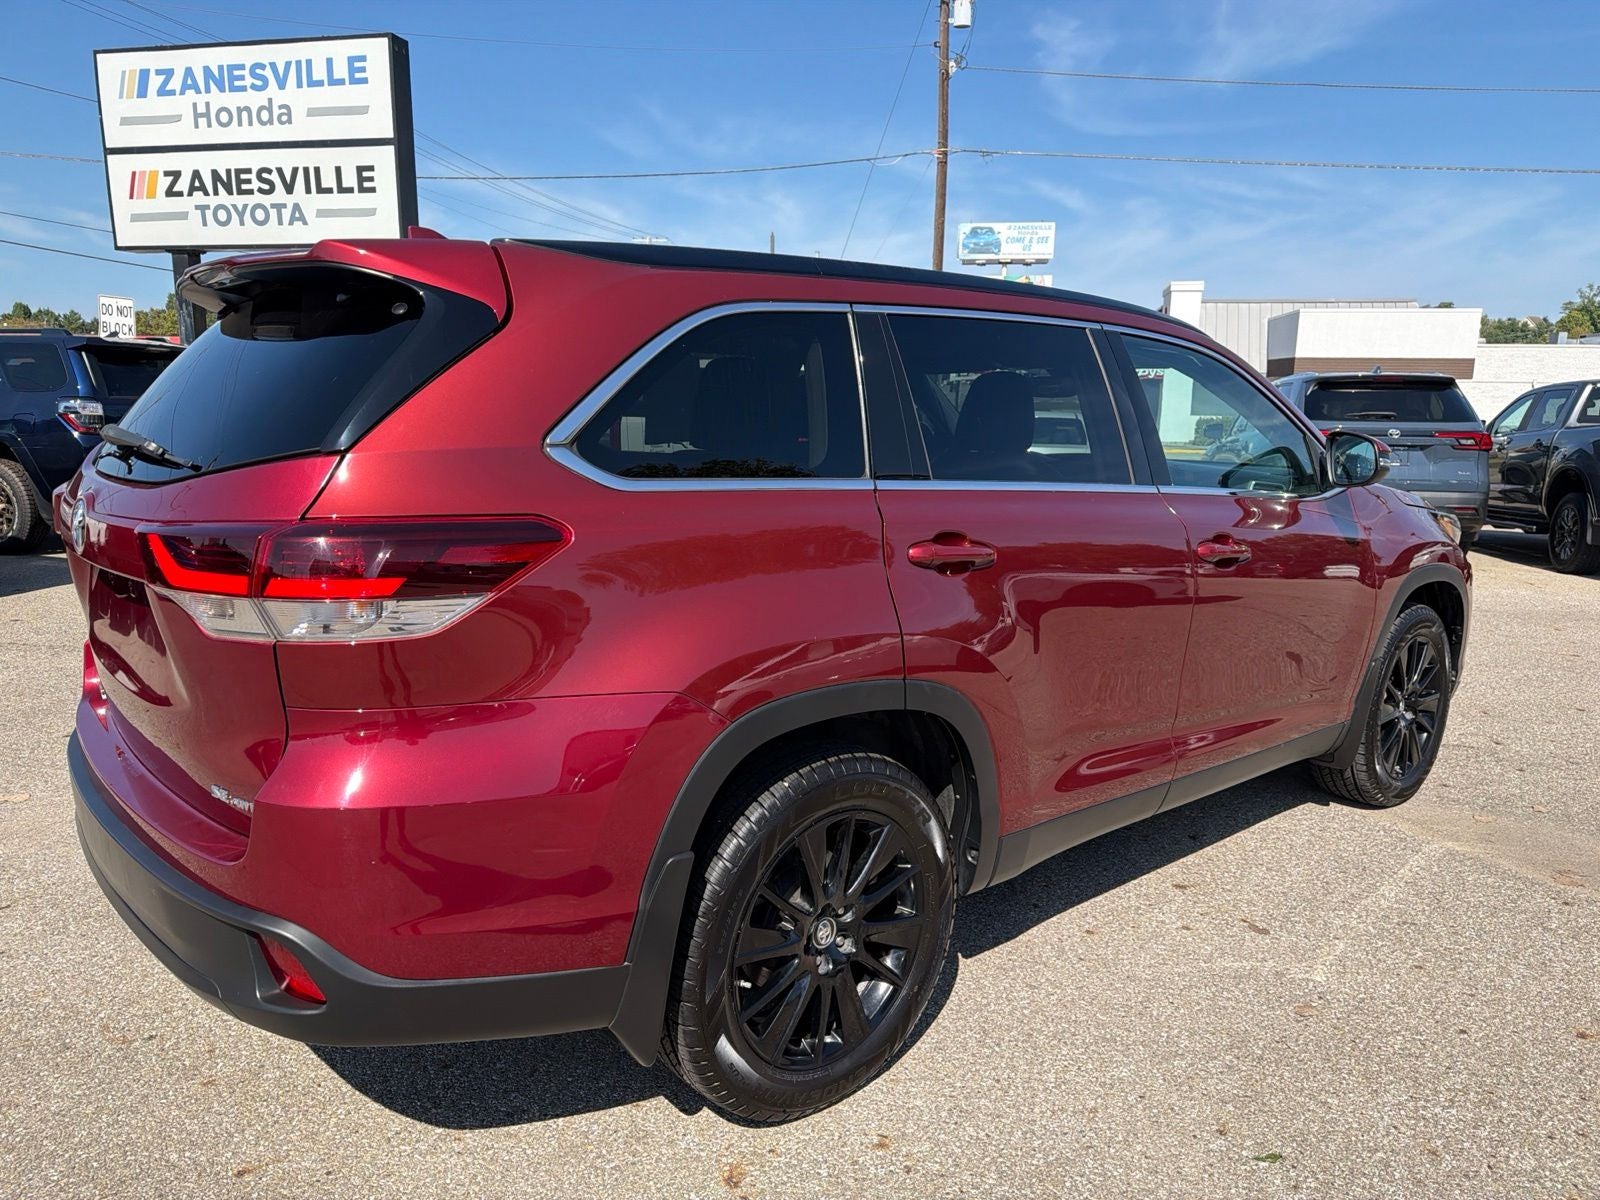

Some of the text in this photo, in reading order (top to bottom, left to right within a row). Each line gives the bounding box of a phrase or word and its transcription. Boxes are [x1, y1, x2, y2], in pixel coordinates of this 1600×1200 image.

[155, 55, 369, 97] ZANESVILLE
[192, 98, 293, 129] Honda
[162, 165, 377, 198] ZANESVILLE
[194, 202, 309, 228] TOYOTA
[1006, 236, 1026, 244] COME
[1037, 236, 1050, 244] SEE
[101, 303, 133, 318] DO NOT
[102, 321, 134, 336] BLOCK
